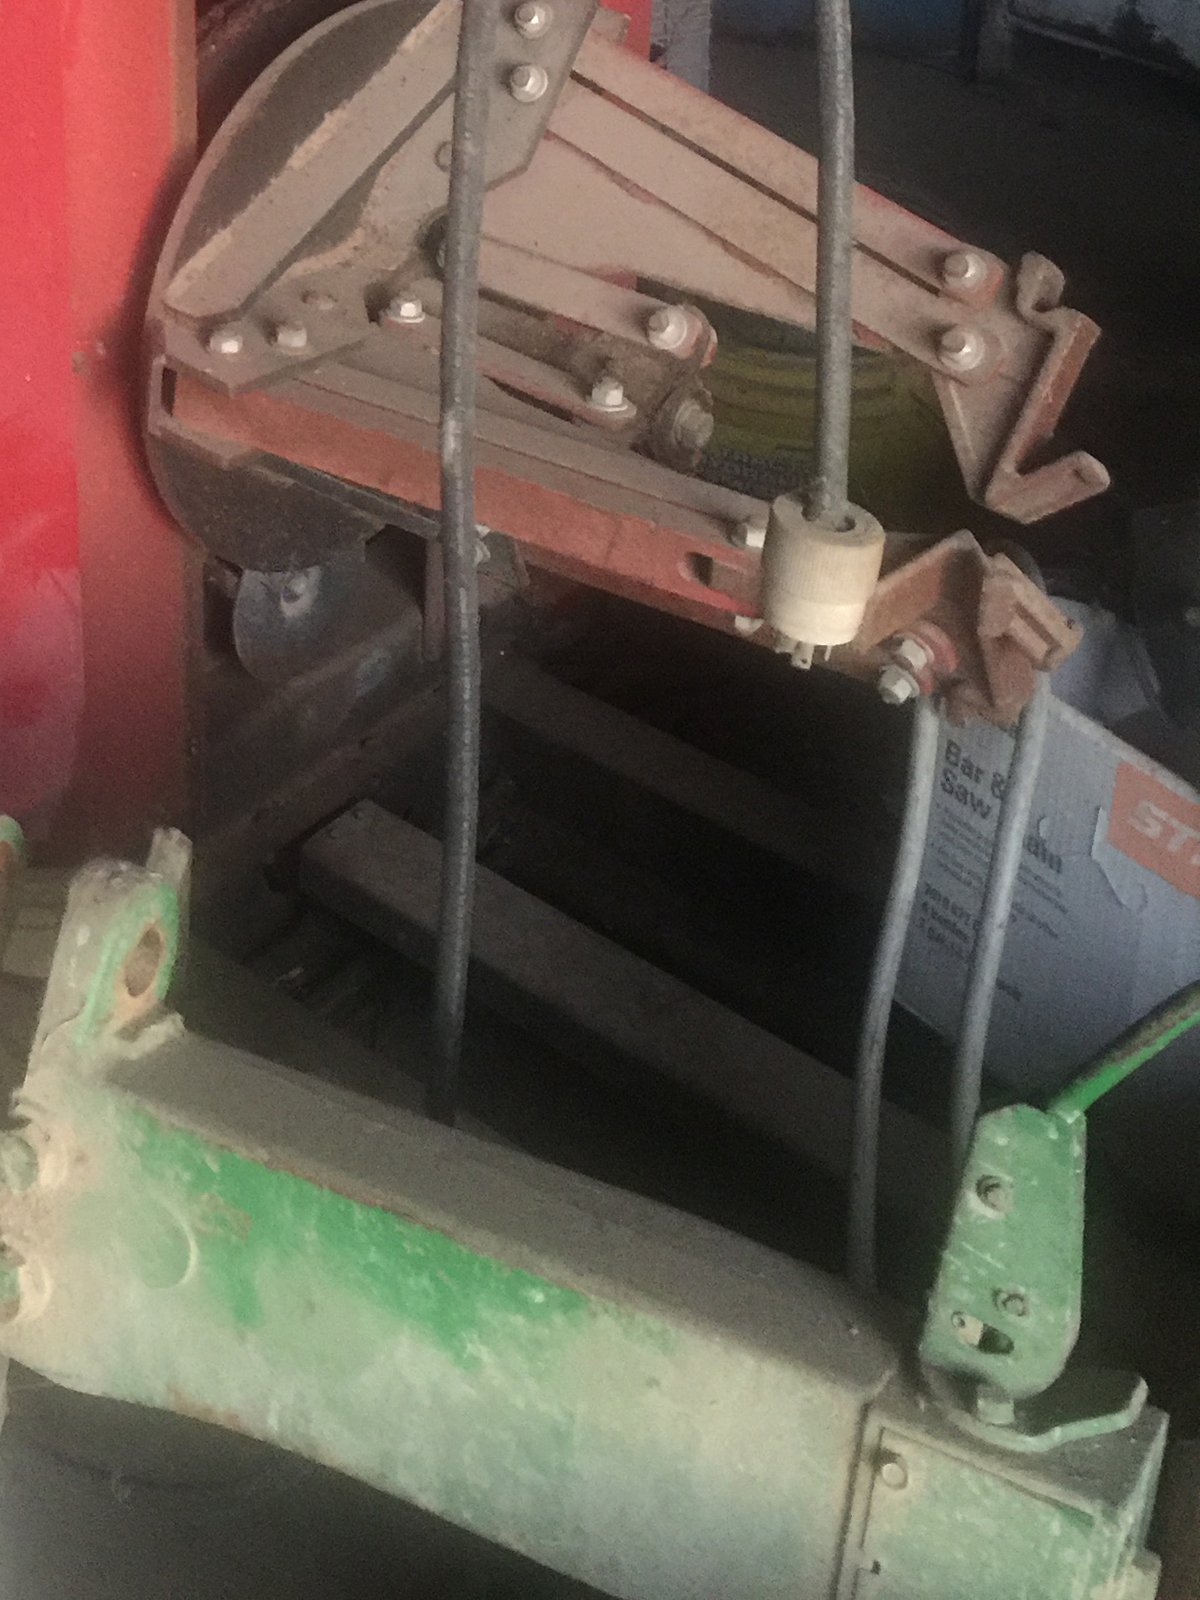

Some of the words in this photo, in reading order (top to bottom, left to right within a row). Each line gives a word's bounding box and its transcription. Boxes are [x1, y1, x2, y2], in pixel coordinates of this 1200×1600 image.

[945, 738, 985, 784] Bar
[940, 767, 992, 820] Saw
[1129, 800, 1200, 866] ST
